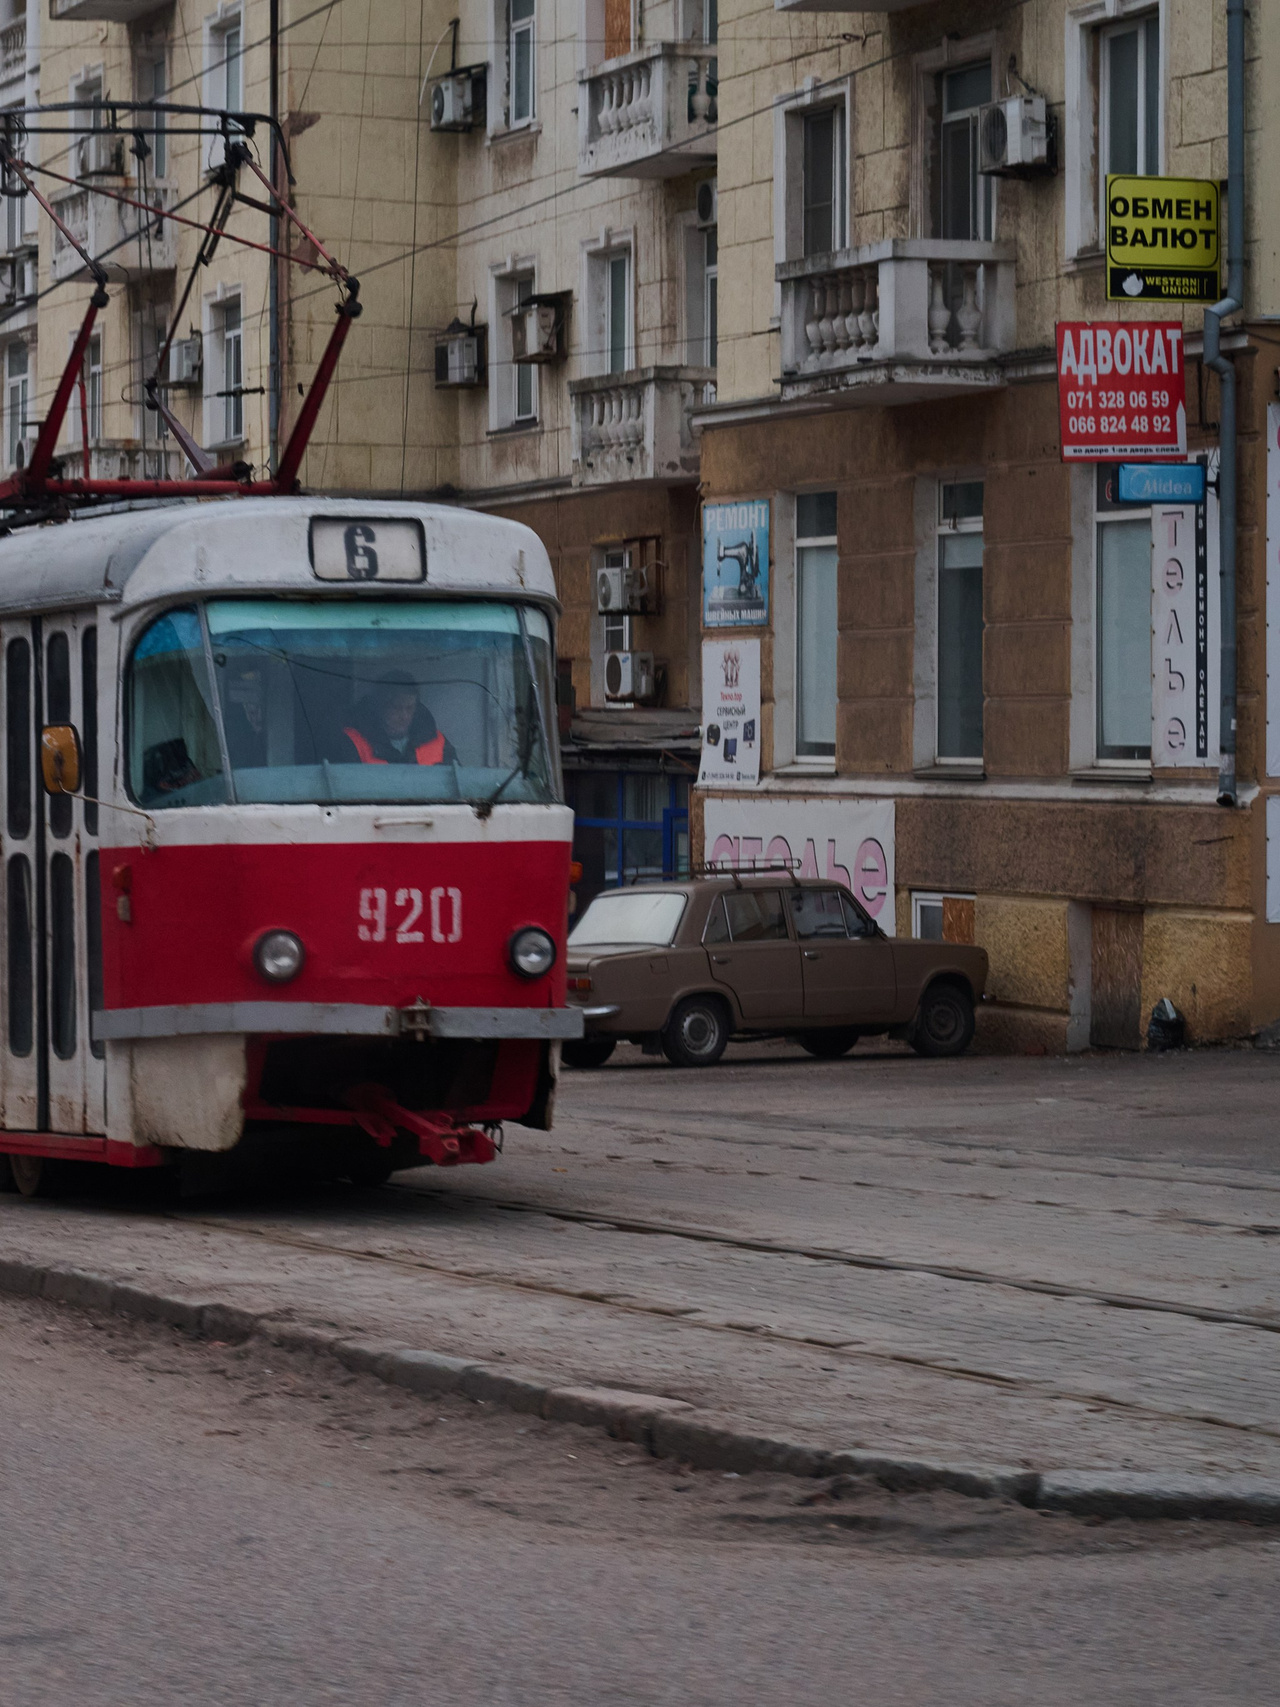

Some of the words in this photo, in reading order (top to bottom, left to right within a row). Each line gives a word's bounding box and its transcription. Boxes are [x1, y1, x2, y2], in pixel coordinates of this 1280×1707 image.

[1109, 196, 1212, 221] ОБМЕН
[1111, 226, 1216, 250] ВАЛЮТ
[1145, 276, 1197, 287] WESTERN
[1161, 285, 1197, 295] UNION
[1061, 328, 1181, 386] АДВОКАТ
[1067, 391, 1093, 409] 071
[1098, 391, 1125, 409] 328
[1129, 391, 1148, 408] 06
[1151, 390, 1169, 408] 59
[1069, 416, 1096, 434] 066
[1100, 415, 1127, 433] 824
[1131, 415, 1149, 433] 48
[1153, 415, 1171, 433] 92
[1084, 447, 1109, 455] дворе
[1130, 446, 1154, 454] дверь
[1143, 479, 1192, 495] Midea
[706, 504, 767, 532] РЕМОНТ
[344, 524, 379, 580] 6
[705, 607, 740, 622] ШВЕЙНЫХ
[740, 608, 767, 620] МАШИН
[717, 704, 746, 717] СЕРВИСНЫЙ
[723, 720, 739, 731] ЦЕНТР
[358, 886, 462, 943] 920
